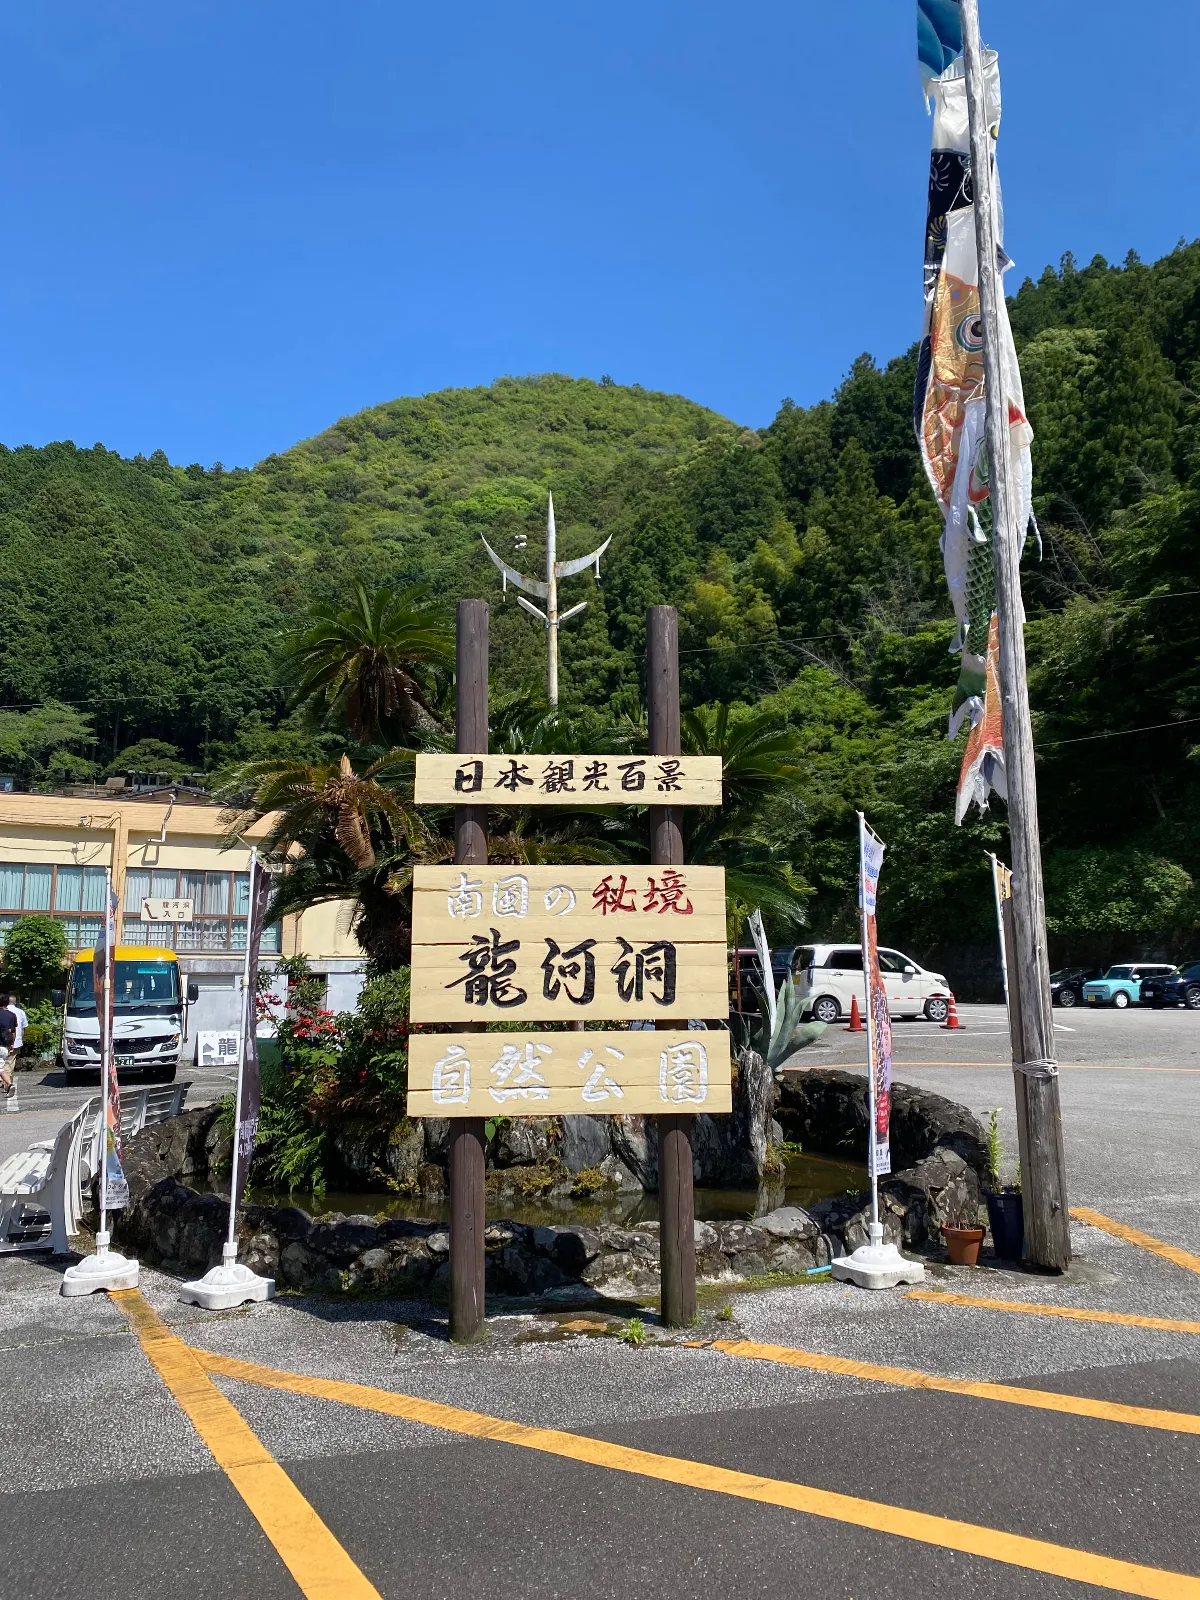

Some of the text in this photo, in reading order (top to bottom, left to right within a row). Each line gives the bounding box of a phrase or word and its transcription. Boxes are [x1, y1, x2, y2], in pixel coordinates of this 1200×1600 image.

[453, 759, 686, 793] 日本観光百景
[163, 910, 185, 919] 入口
[448, 870, 694, 919] 南国の秘境
[444, 927, 677, 1008] 龍河洞
[432, 1039, 708, 1104] 自然公園
